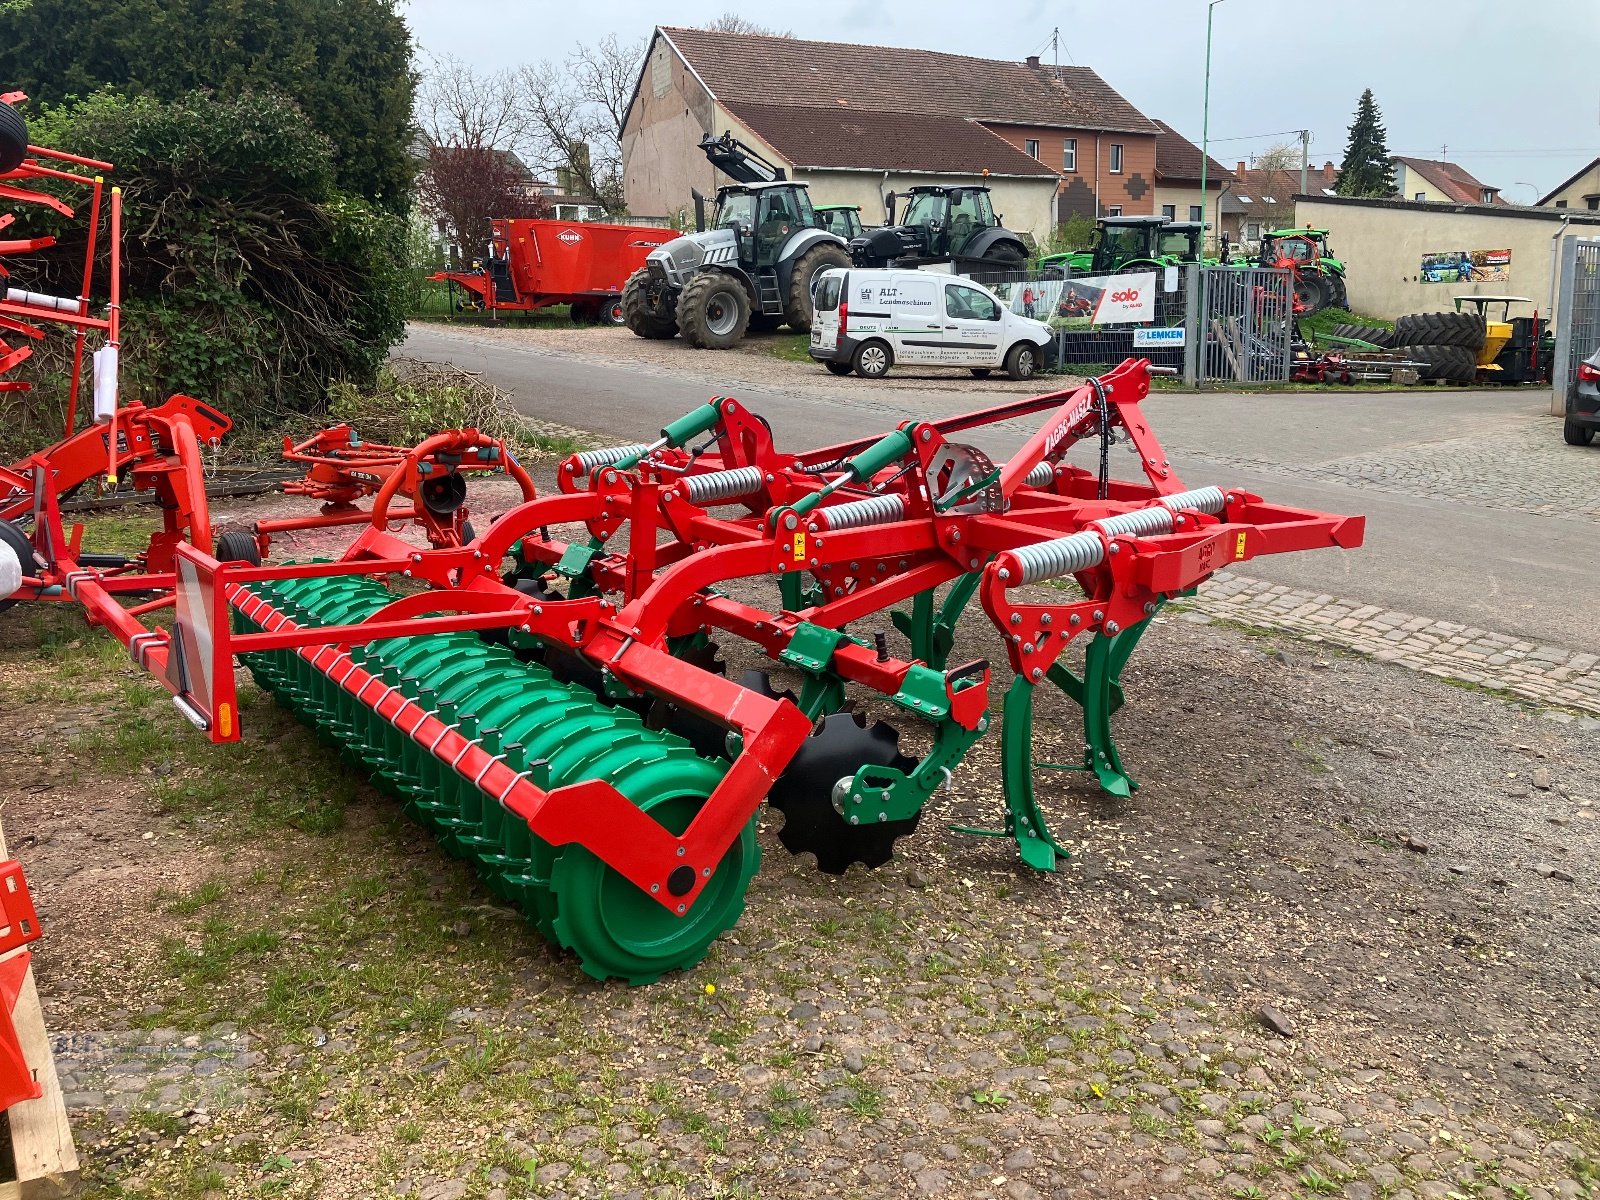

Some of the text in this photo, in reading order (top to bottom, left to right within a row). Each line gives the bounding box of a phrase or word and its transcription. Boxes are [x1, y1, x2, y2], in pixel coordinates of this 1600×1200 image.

[879, 288, 897, 296] ALT
[879, 298, 931, 306] Landmaschinen
[1147, 331, 1183, 339] LEMKEN
